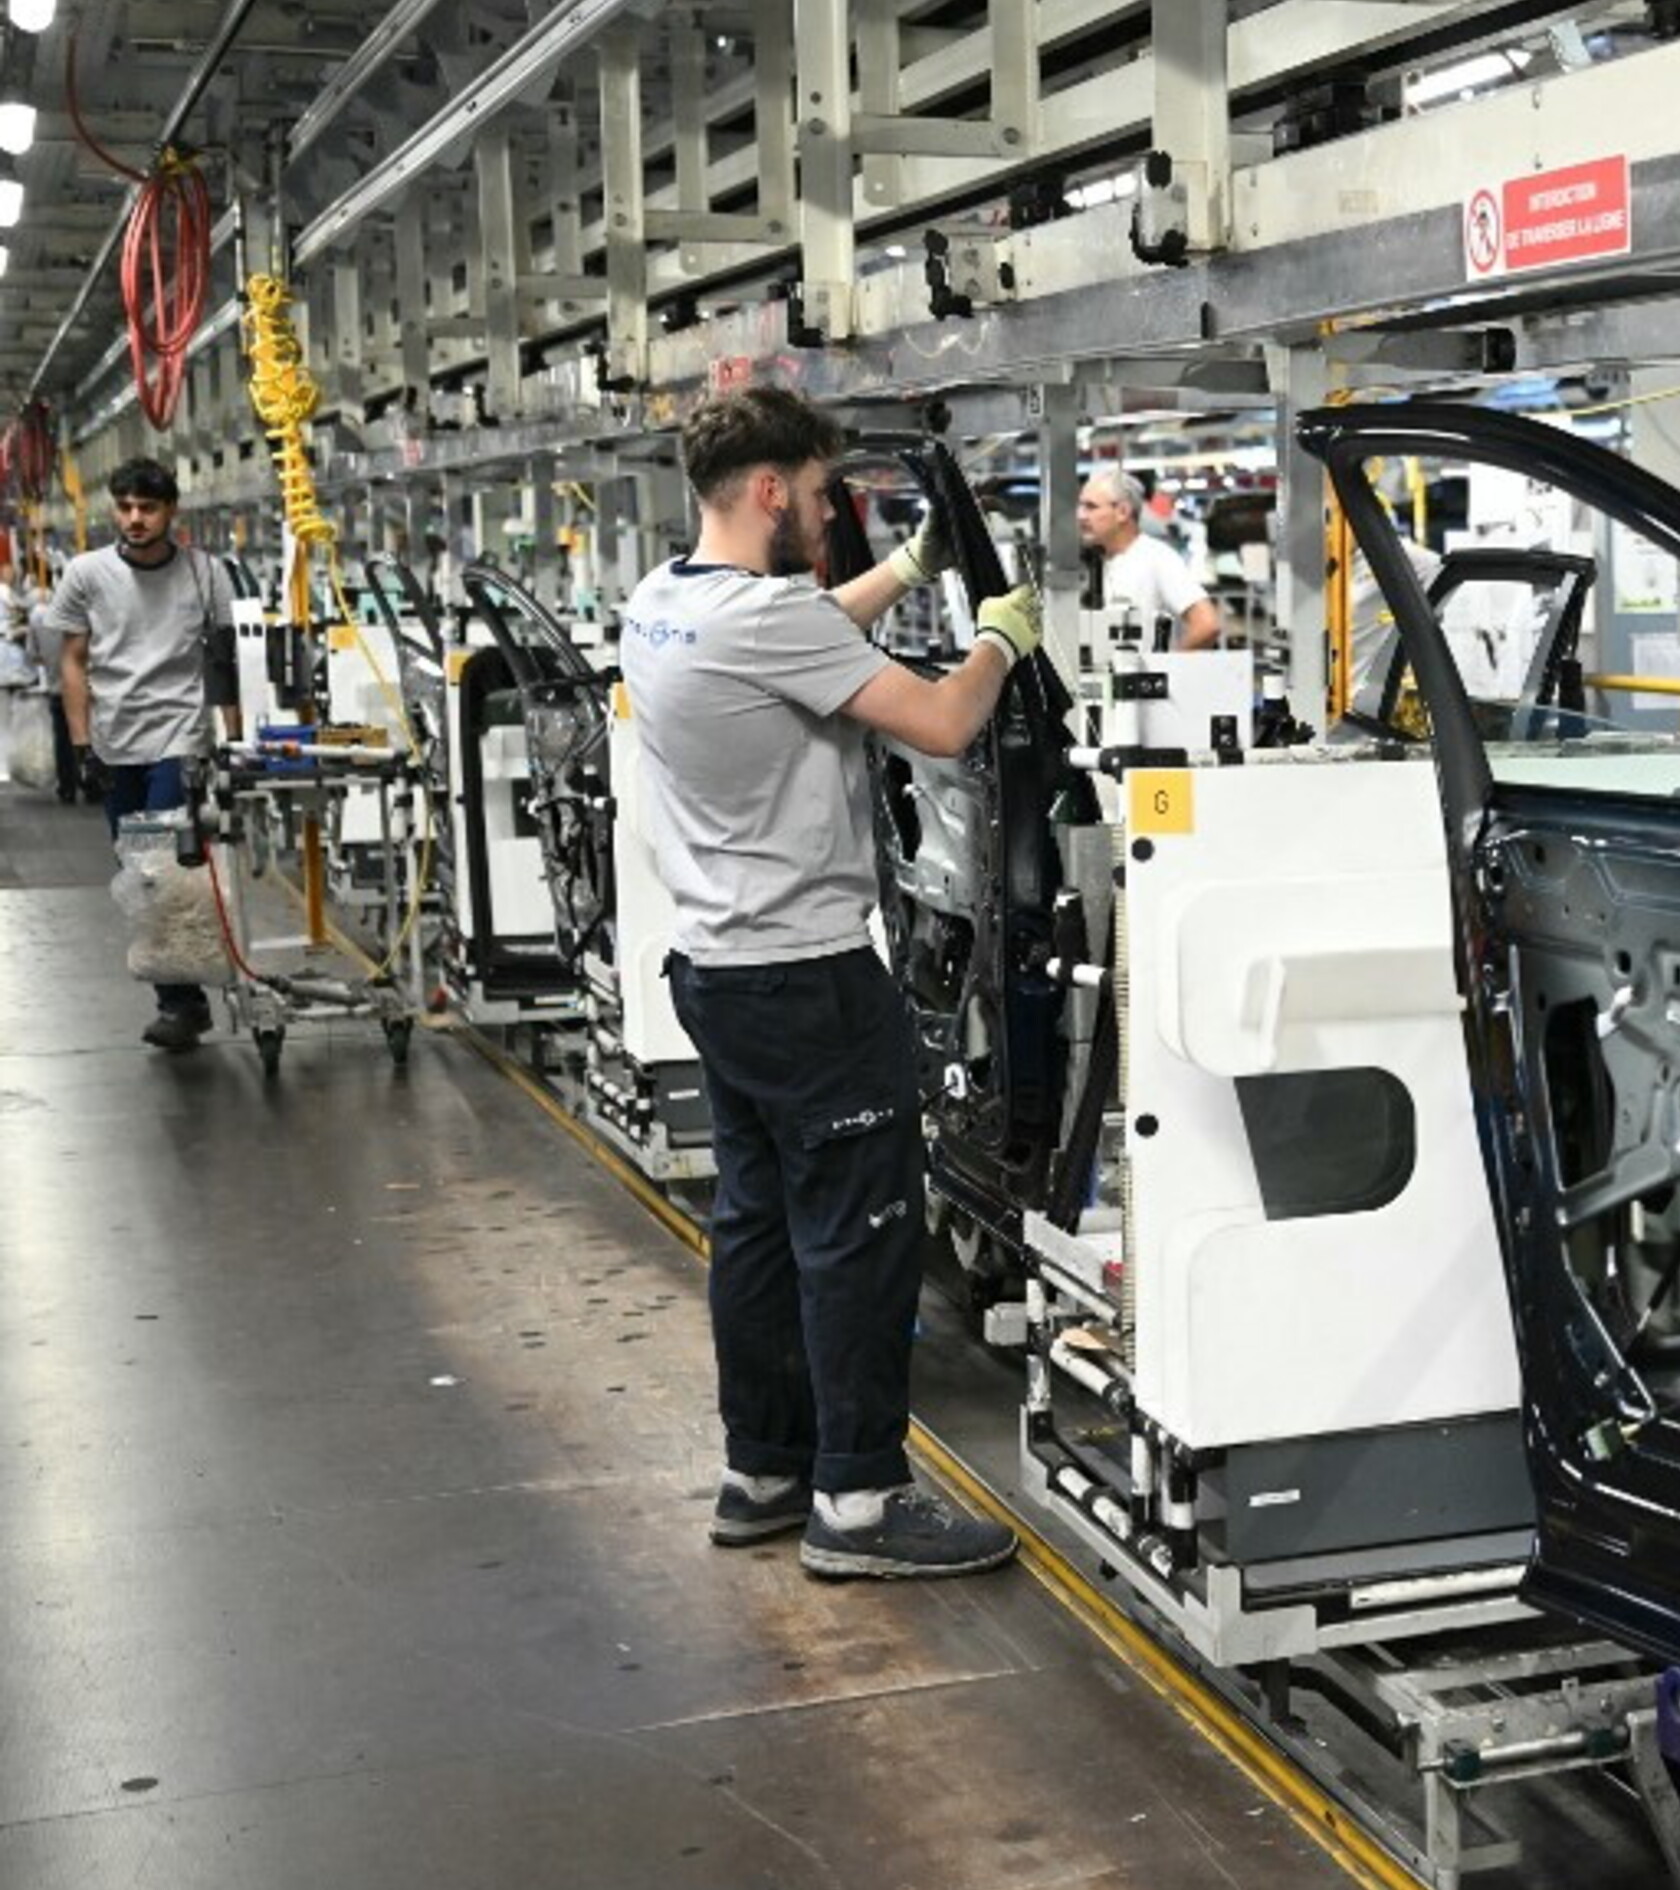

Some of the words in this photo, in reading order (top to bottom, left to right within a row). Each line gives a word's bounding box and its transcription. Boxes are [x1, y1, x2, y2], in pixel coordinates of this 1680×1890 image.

[1507, 232, 1519, 251] DE
[1578, 217, 1592, 236] LA
[1592, 210, 1626, 234] LIGNE
[1154, 789, 1169, 814] G
